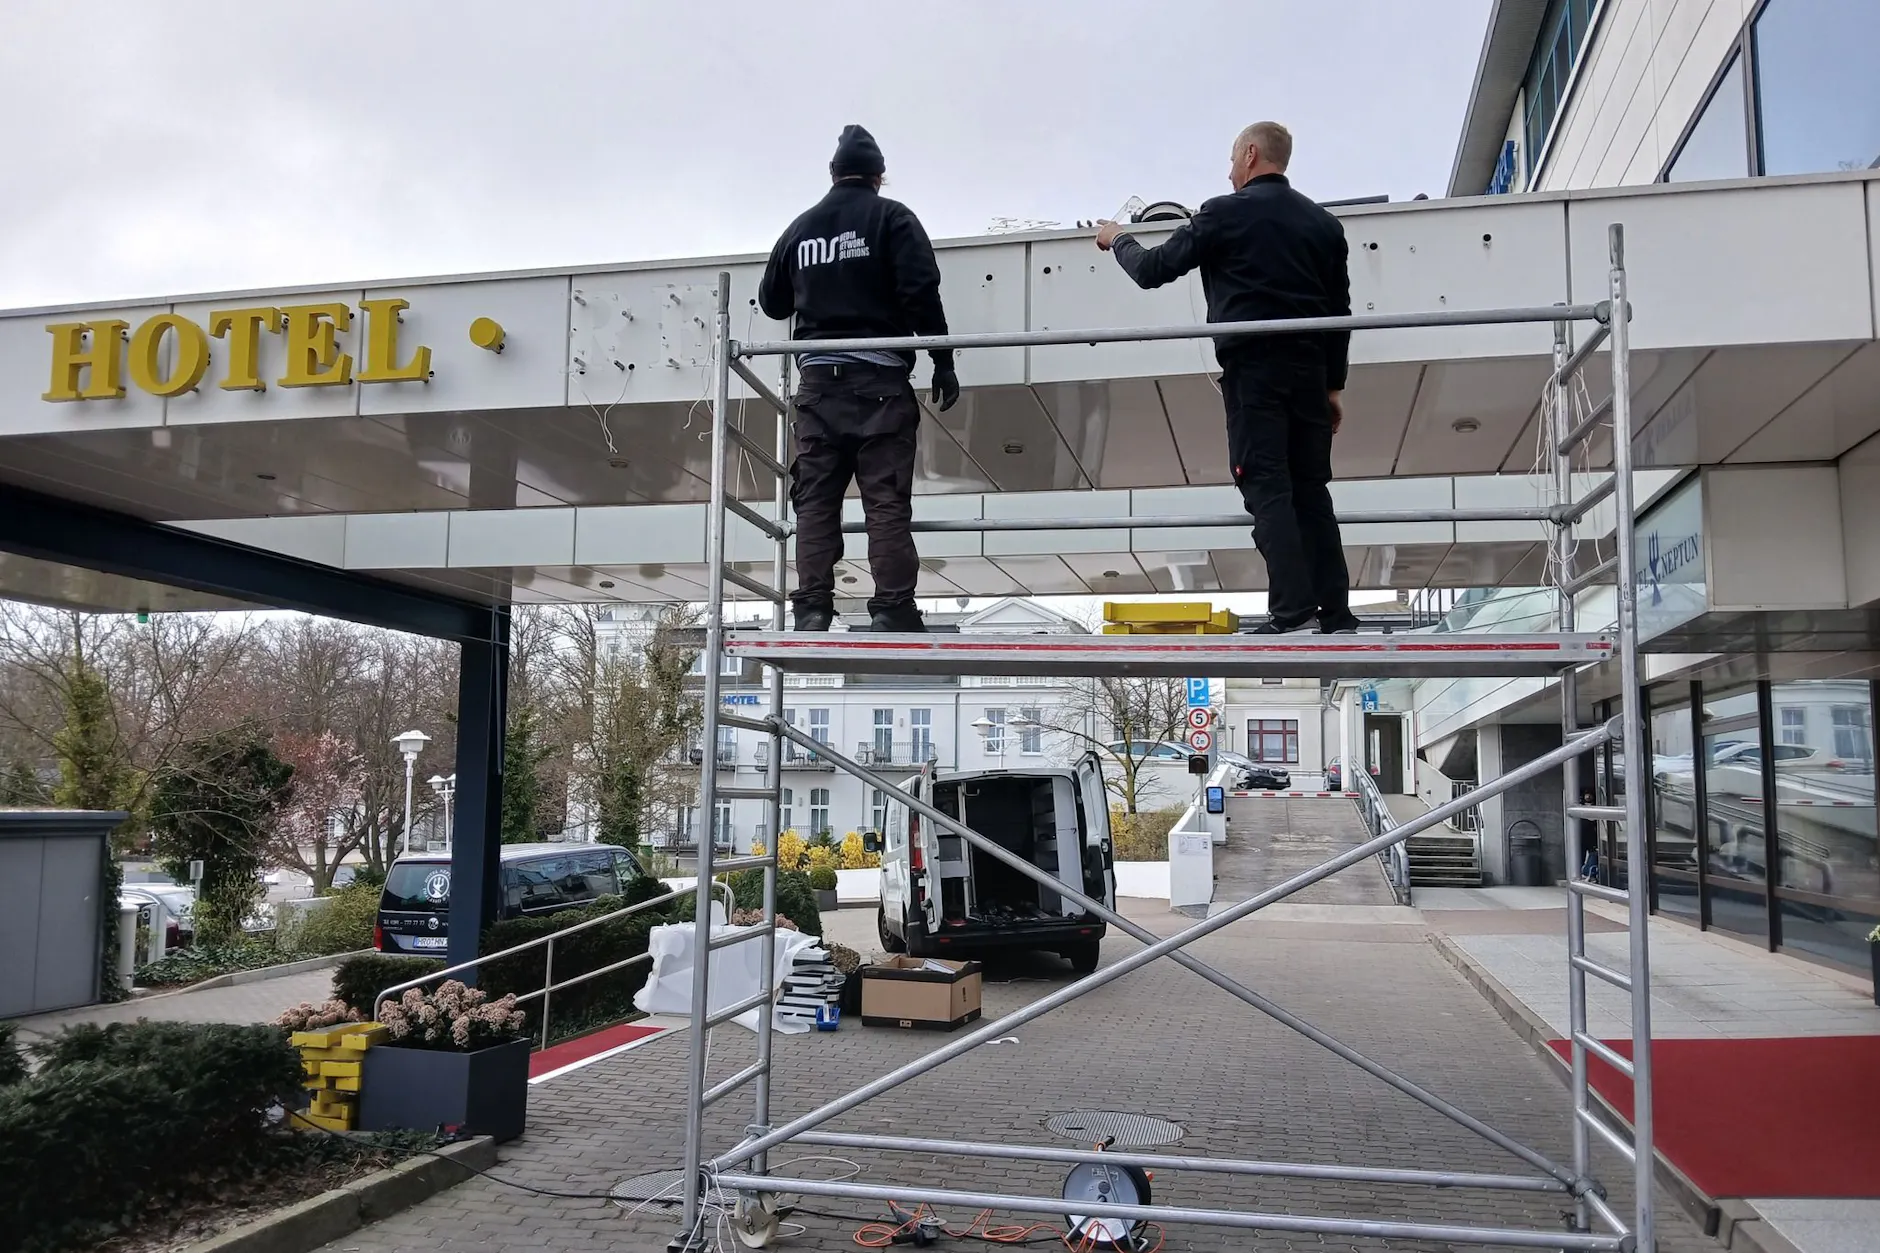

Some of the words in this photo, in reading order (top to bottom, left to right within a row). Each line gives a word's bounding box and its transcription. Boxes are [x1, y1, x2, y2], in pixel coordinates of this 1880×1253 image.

[838, 246, 870, 262] SOLUTIONS
[41, 298, 431, 402] HOTEL
[1660, 533, 1700, 578] NEPTUN
[1190, 677, 1205, 698] P
[722, 695, 760, 705] HOTEL
[1195, 713, 1203, 725] 5
